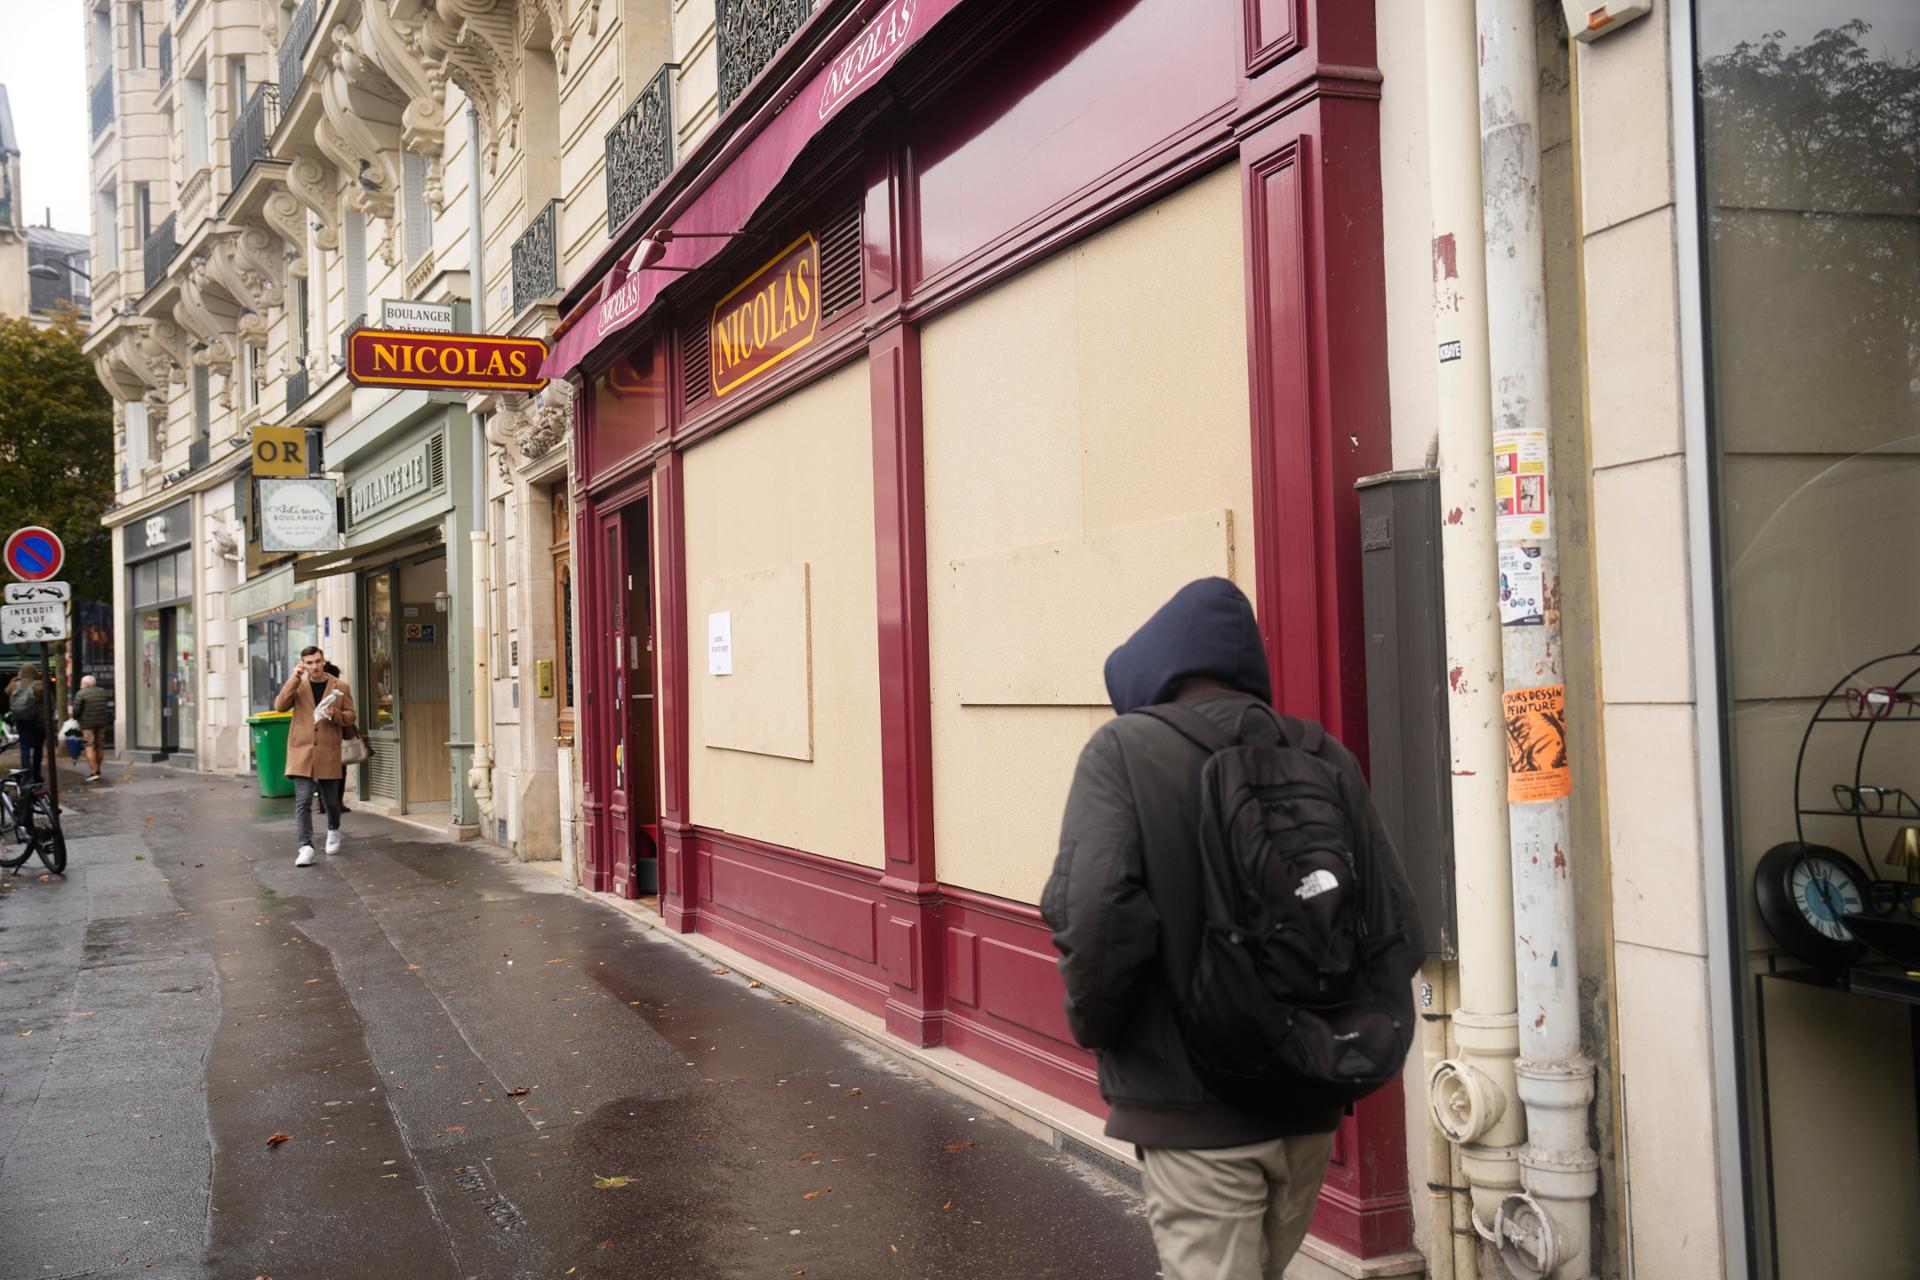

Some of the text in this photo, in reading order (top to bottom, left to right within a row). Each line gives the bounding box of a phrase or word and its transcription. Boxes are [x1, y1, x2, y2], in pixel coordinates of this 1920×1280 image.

[824, 0, 912, 106] NICOLAS
[600, 276, 638, 328] NICOLAS
[386, 307, 451, 322] BOULANGER
[716, 258, 811, 376] NICOLAS
[372, 343, 527, 377] NICOLAS
[257, 440, 303, 463] OR
[352, 455, 423, 516] BOULANGERIE
[10, 606, 54, 616] INTERDIT
[20, 616, 46, 624] SAUF
[1529, 688, 1562, 700] DESSIN
[1507, 700, 1555, 715] PEINTURE
